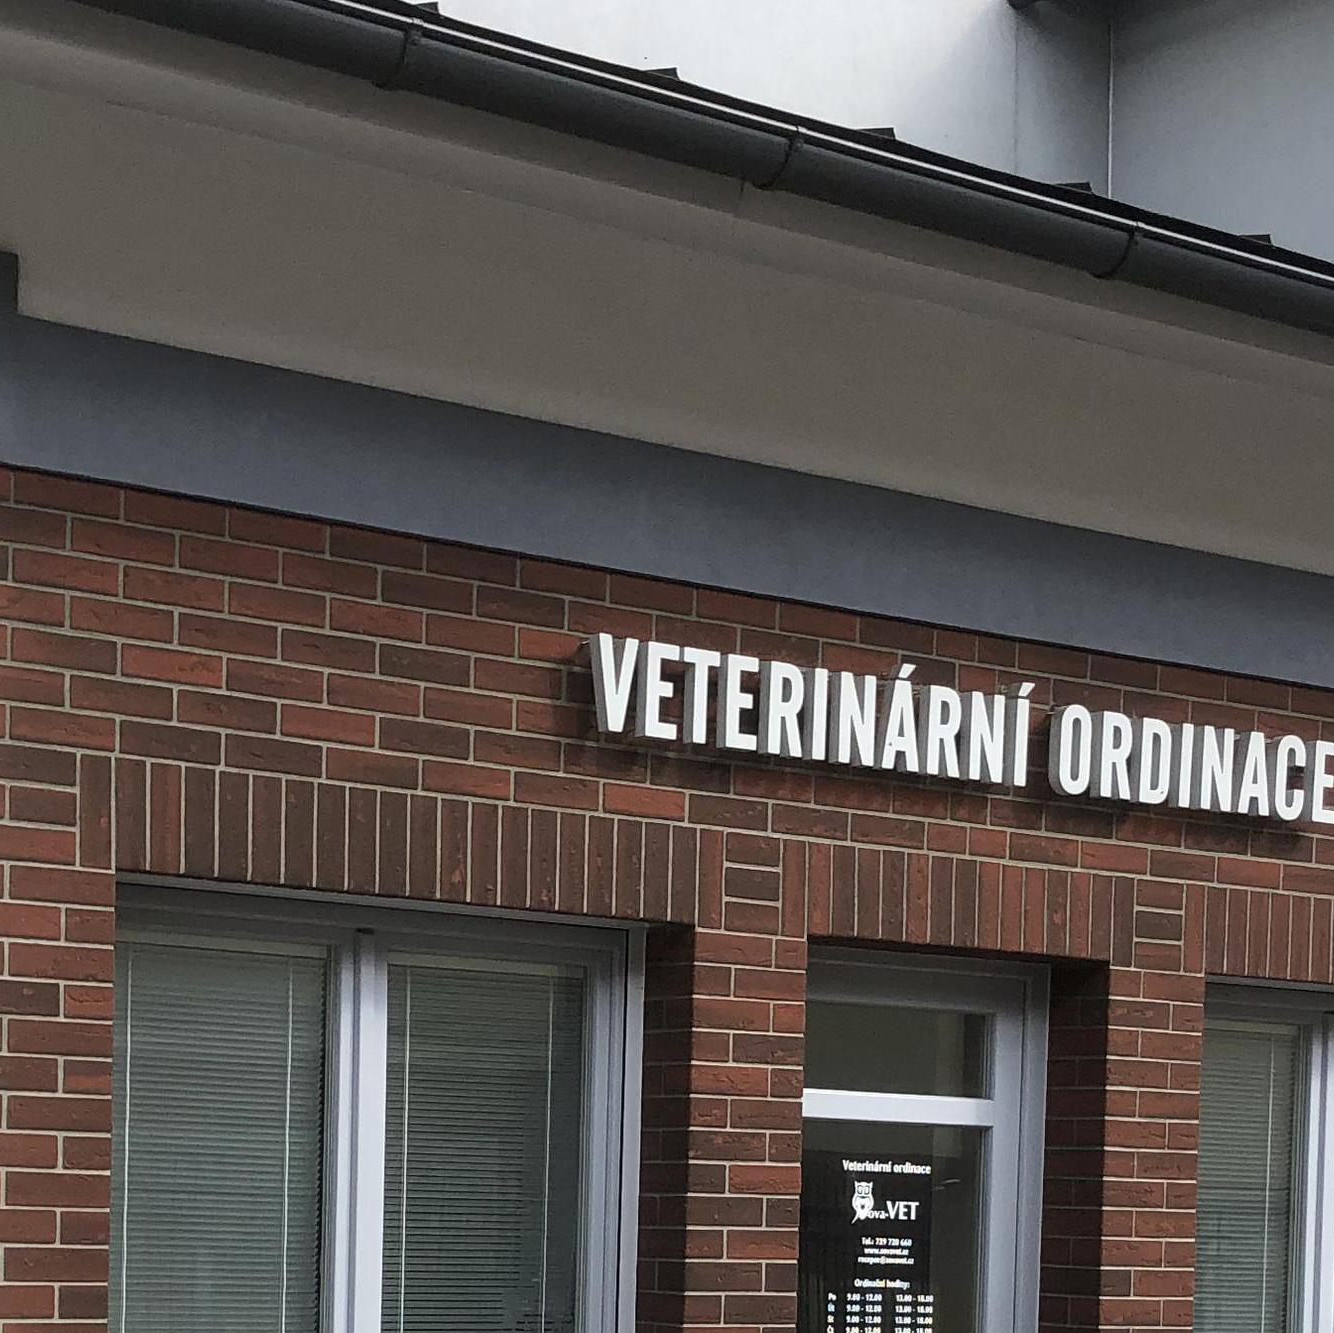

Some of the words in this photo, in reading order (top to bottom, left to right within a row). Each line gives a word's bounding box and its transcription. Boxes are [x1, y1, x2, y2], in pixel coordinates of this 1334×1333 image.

[593, 633, 1034, 788] VETERINÁRNÍ
[842, 1159, 892, 1173] Veterinární
[893, 1161, 932, 1175] ordinace
